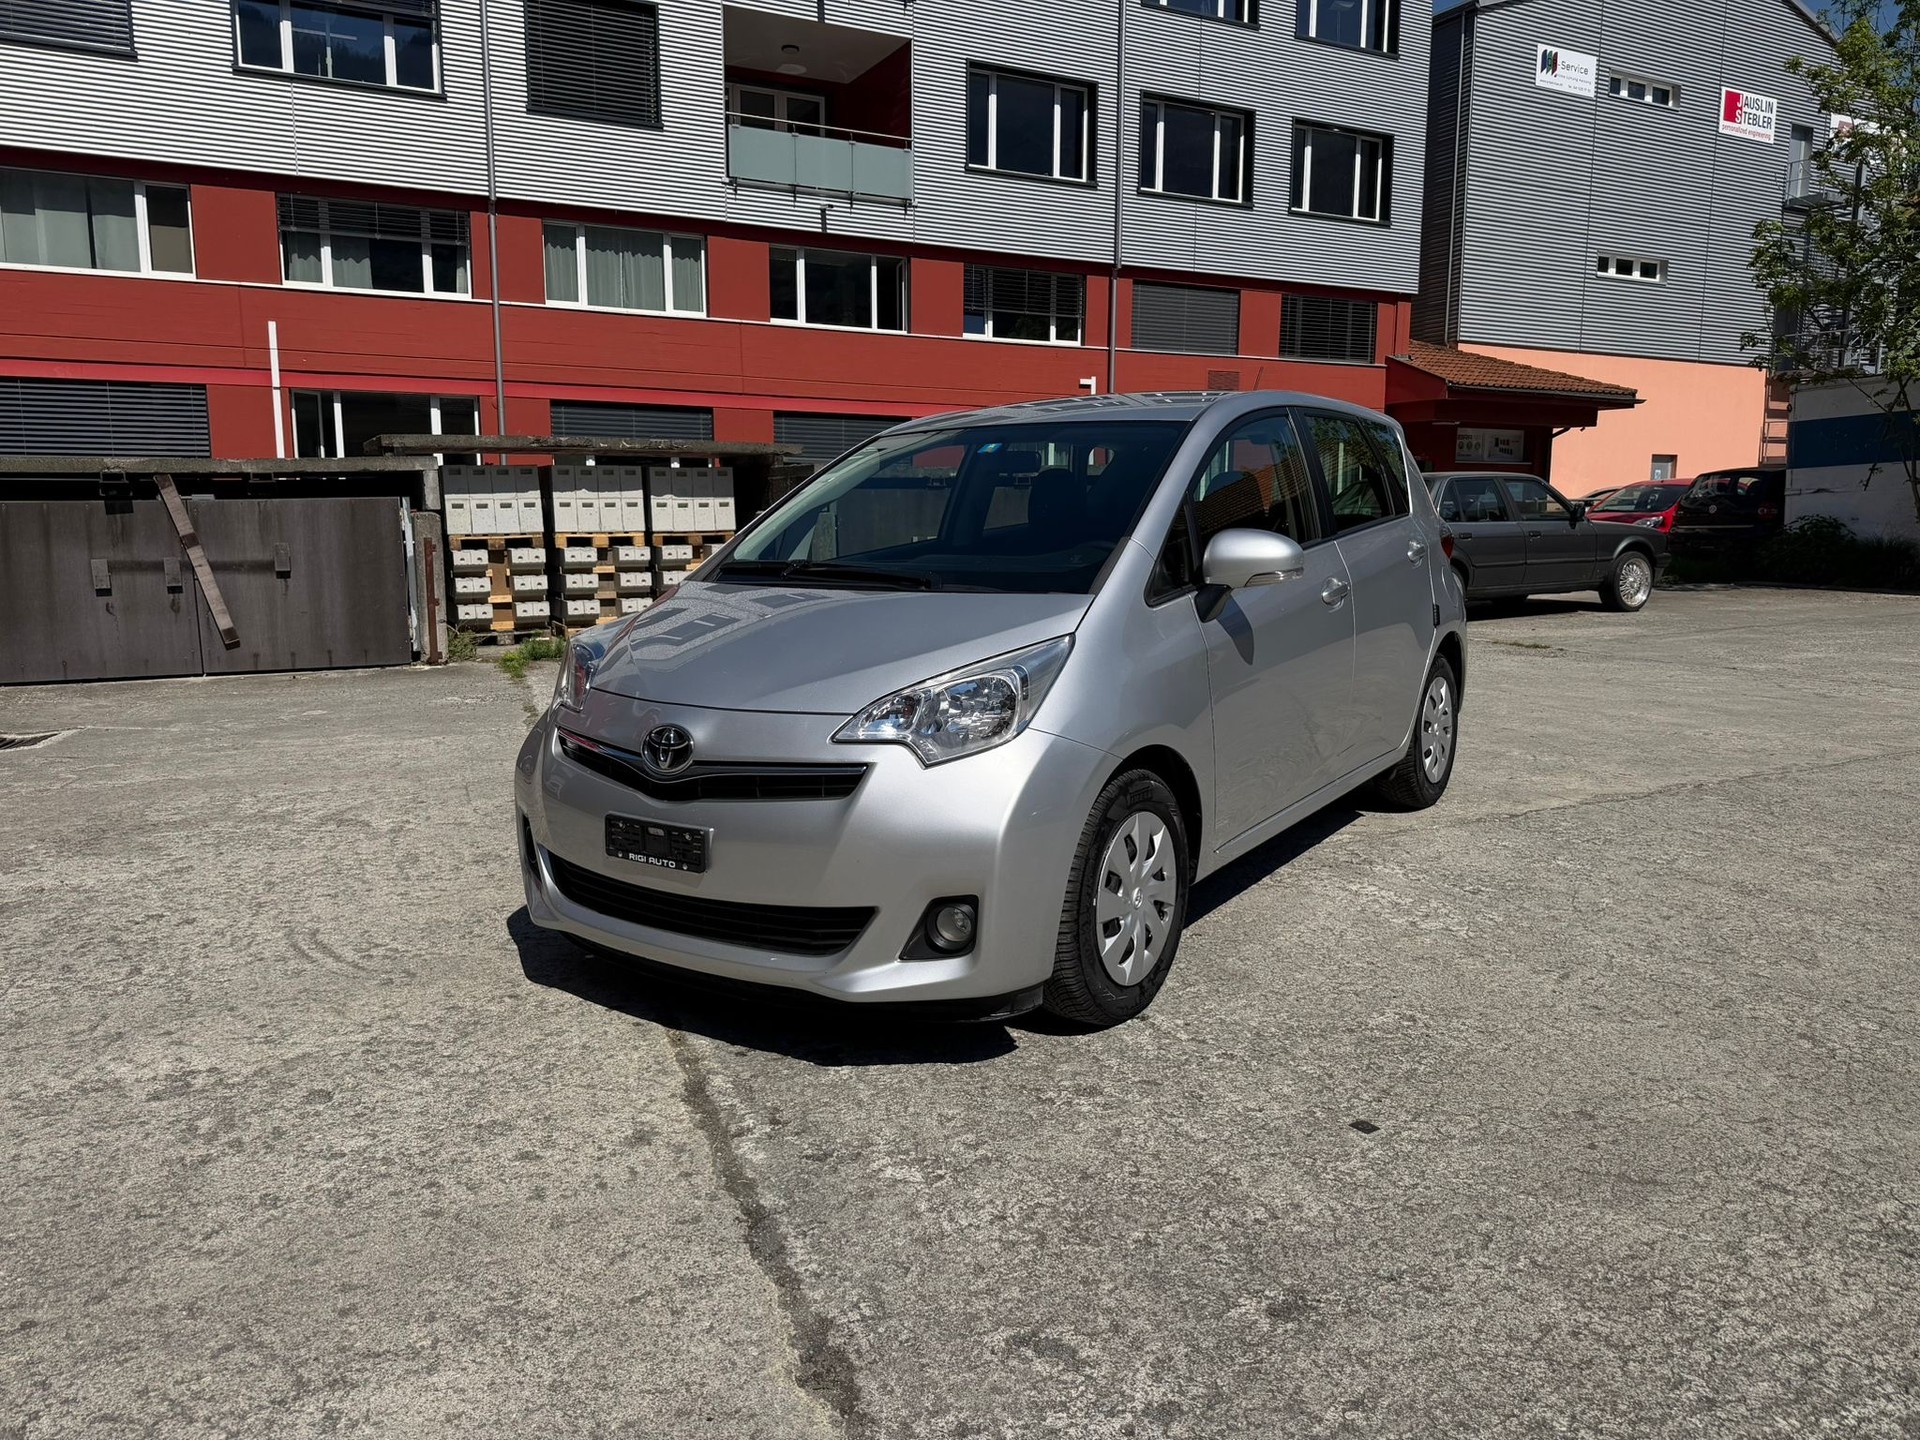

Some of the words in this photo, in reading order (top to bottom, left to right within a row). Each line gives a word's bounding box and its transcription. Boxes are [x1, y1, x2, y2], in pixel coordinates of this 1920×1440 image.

[1737, 94, 1773, 114] JAUSLIN
[1735, 109, 1772, 129] STEBLER
[628, 852, 647, 863] RIGI
[648, 857, 676, 868] AUTO
